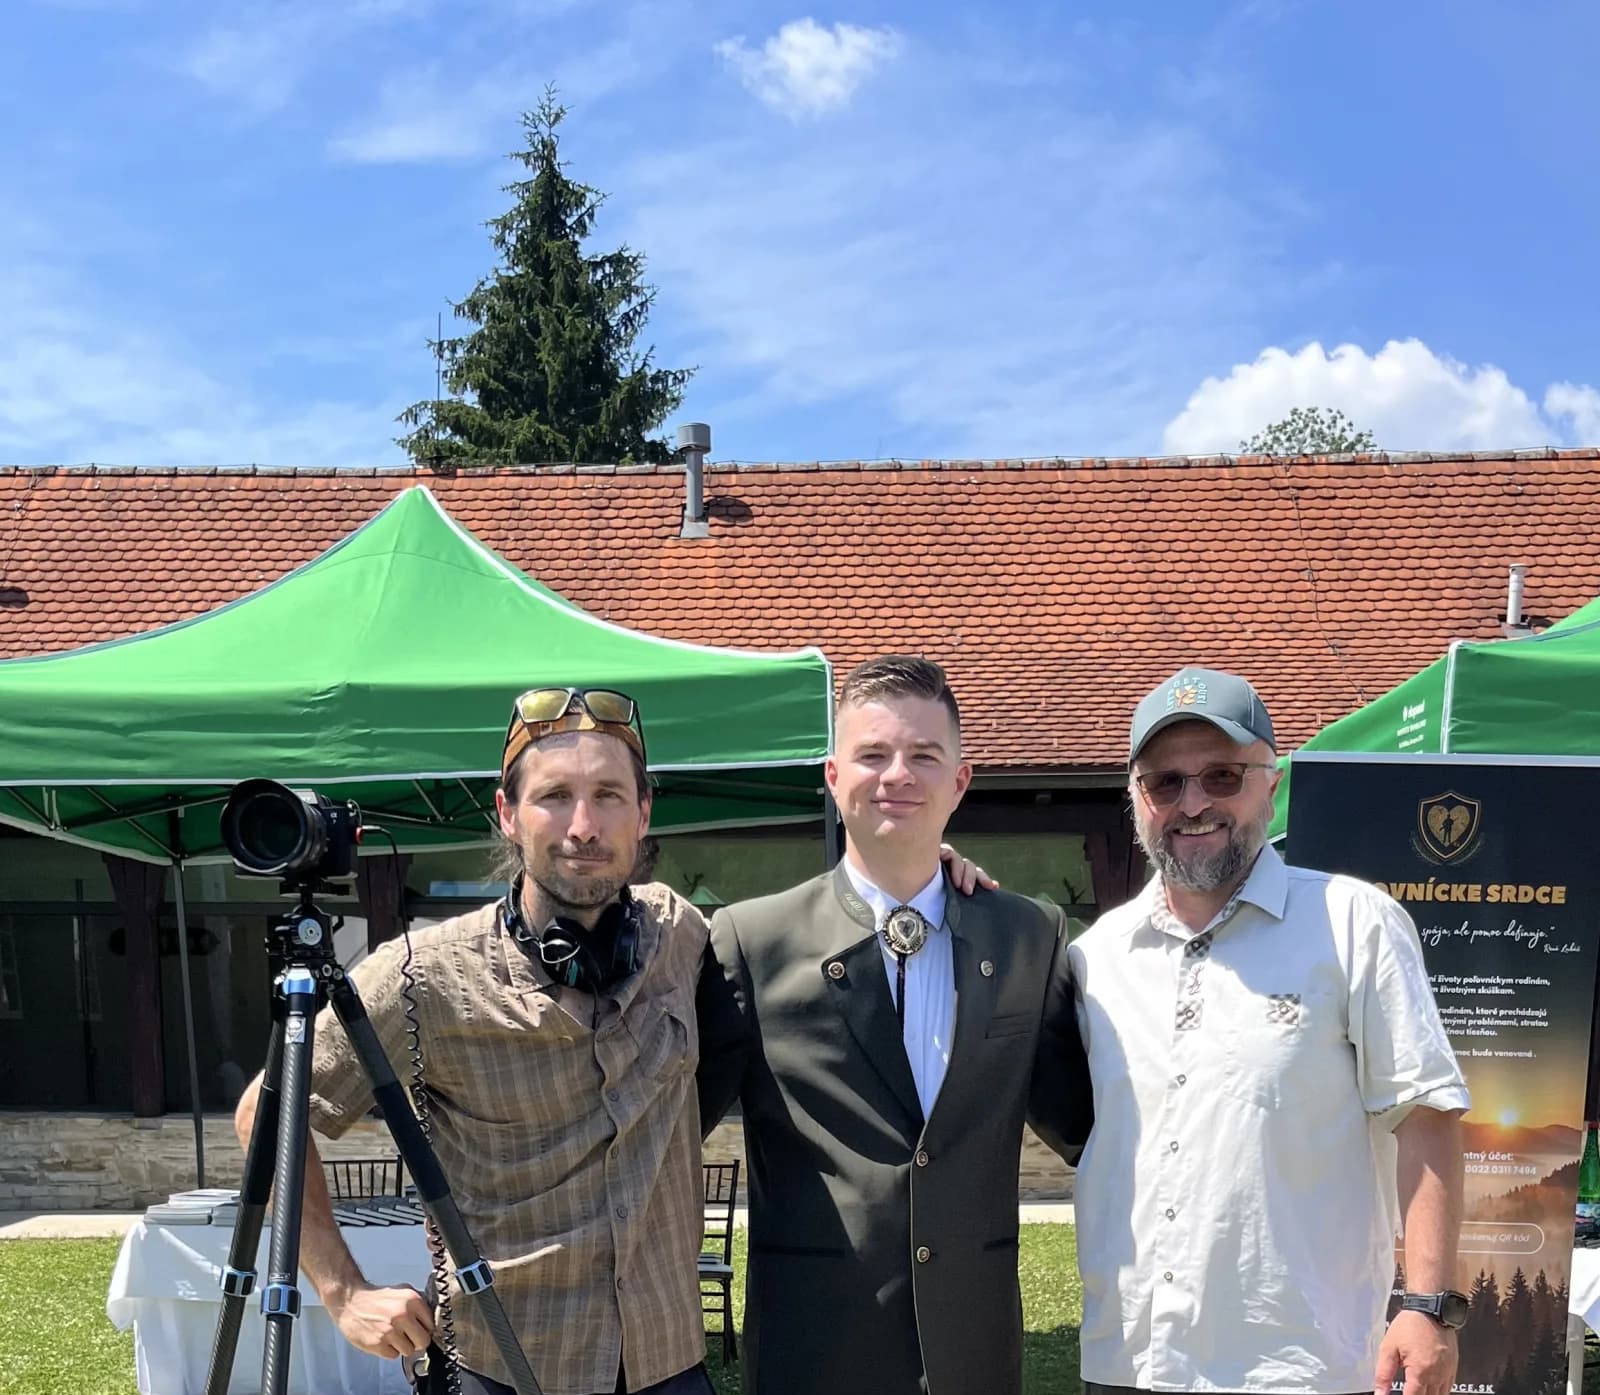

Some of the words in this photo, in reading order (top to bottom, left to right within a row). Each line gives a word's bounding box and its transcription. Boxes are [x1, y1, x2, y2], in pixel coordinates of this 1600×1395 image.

[1486, 884, 1567, 904] SRDCE
[1453, 920, 1470, 936] ale
[1469, 929, 1502, 944] pomoc
[1499, 1007, 1548, 1018] prechádzajú
[1467, 1018, 1519, 1027] problémami,
[1520, 1019, 1549, 1027] stratou
[1472, 1048, 1493, 1057] bude
